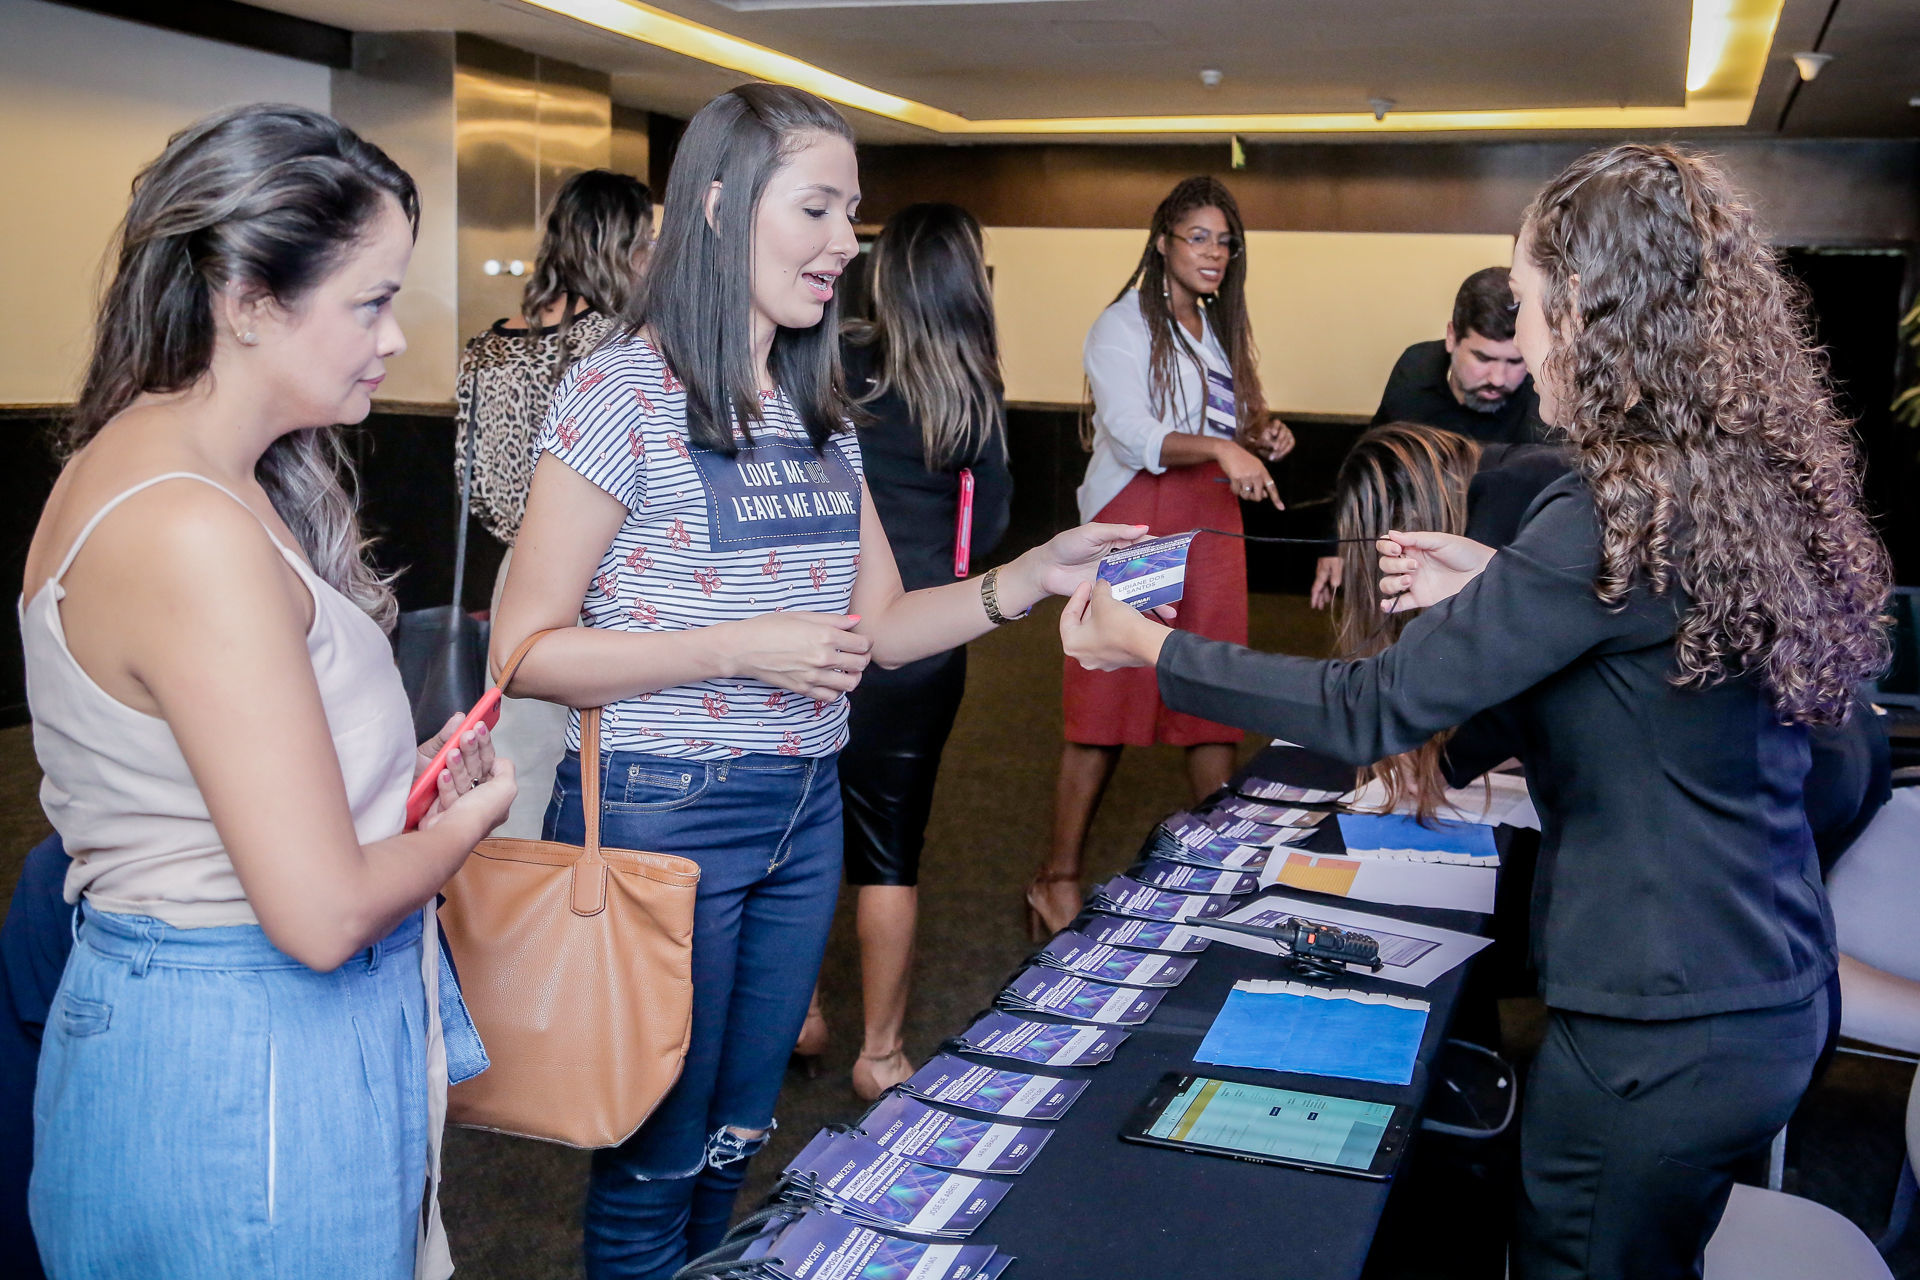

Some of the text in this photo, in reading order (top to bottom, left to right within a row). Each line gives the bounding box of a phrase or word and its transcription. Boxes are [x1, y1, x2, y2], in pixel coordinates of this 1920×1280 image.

[736, 459, 830, 487] LOVE ME OR
[731, 490, 857, 522] LEAVE ME ALONE
[1118, 574, 1165, 593] LIDIANE DOS
[1126, 582, 1156, 595] SANTOS
